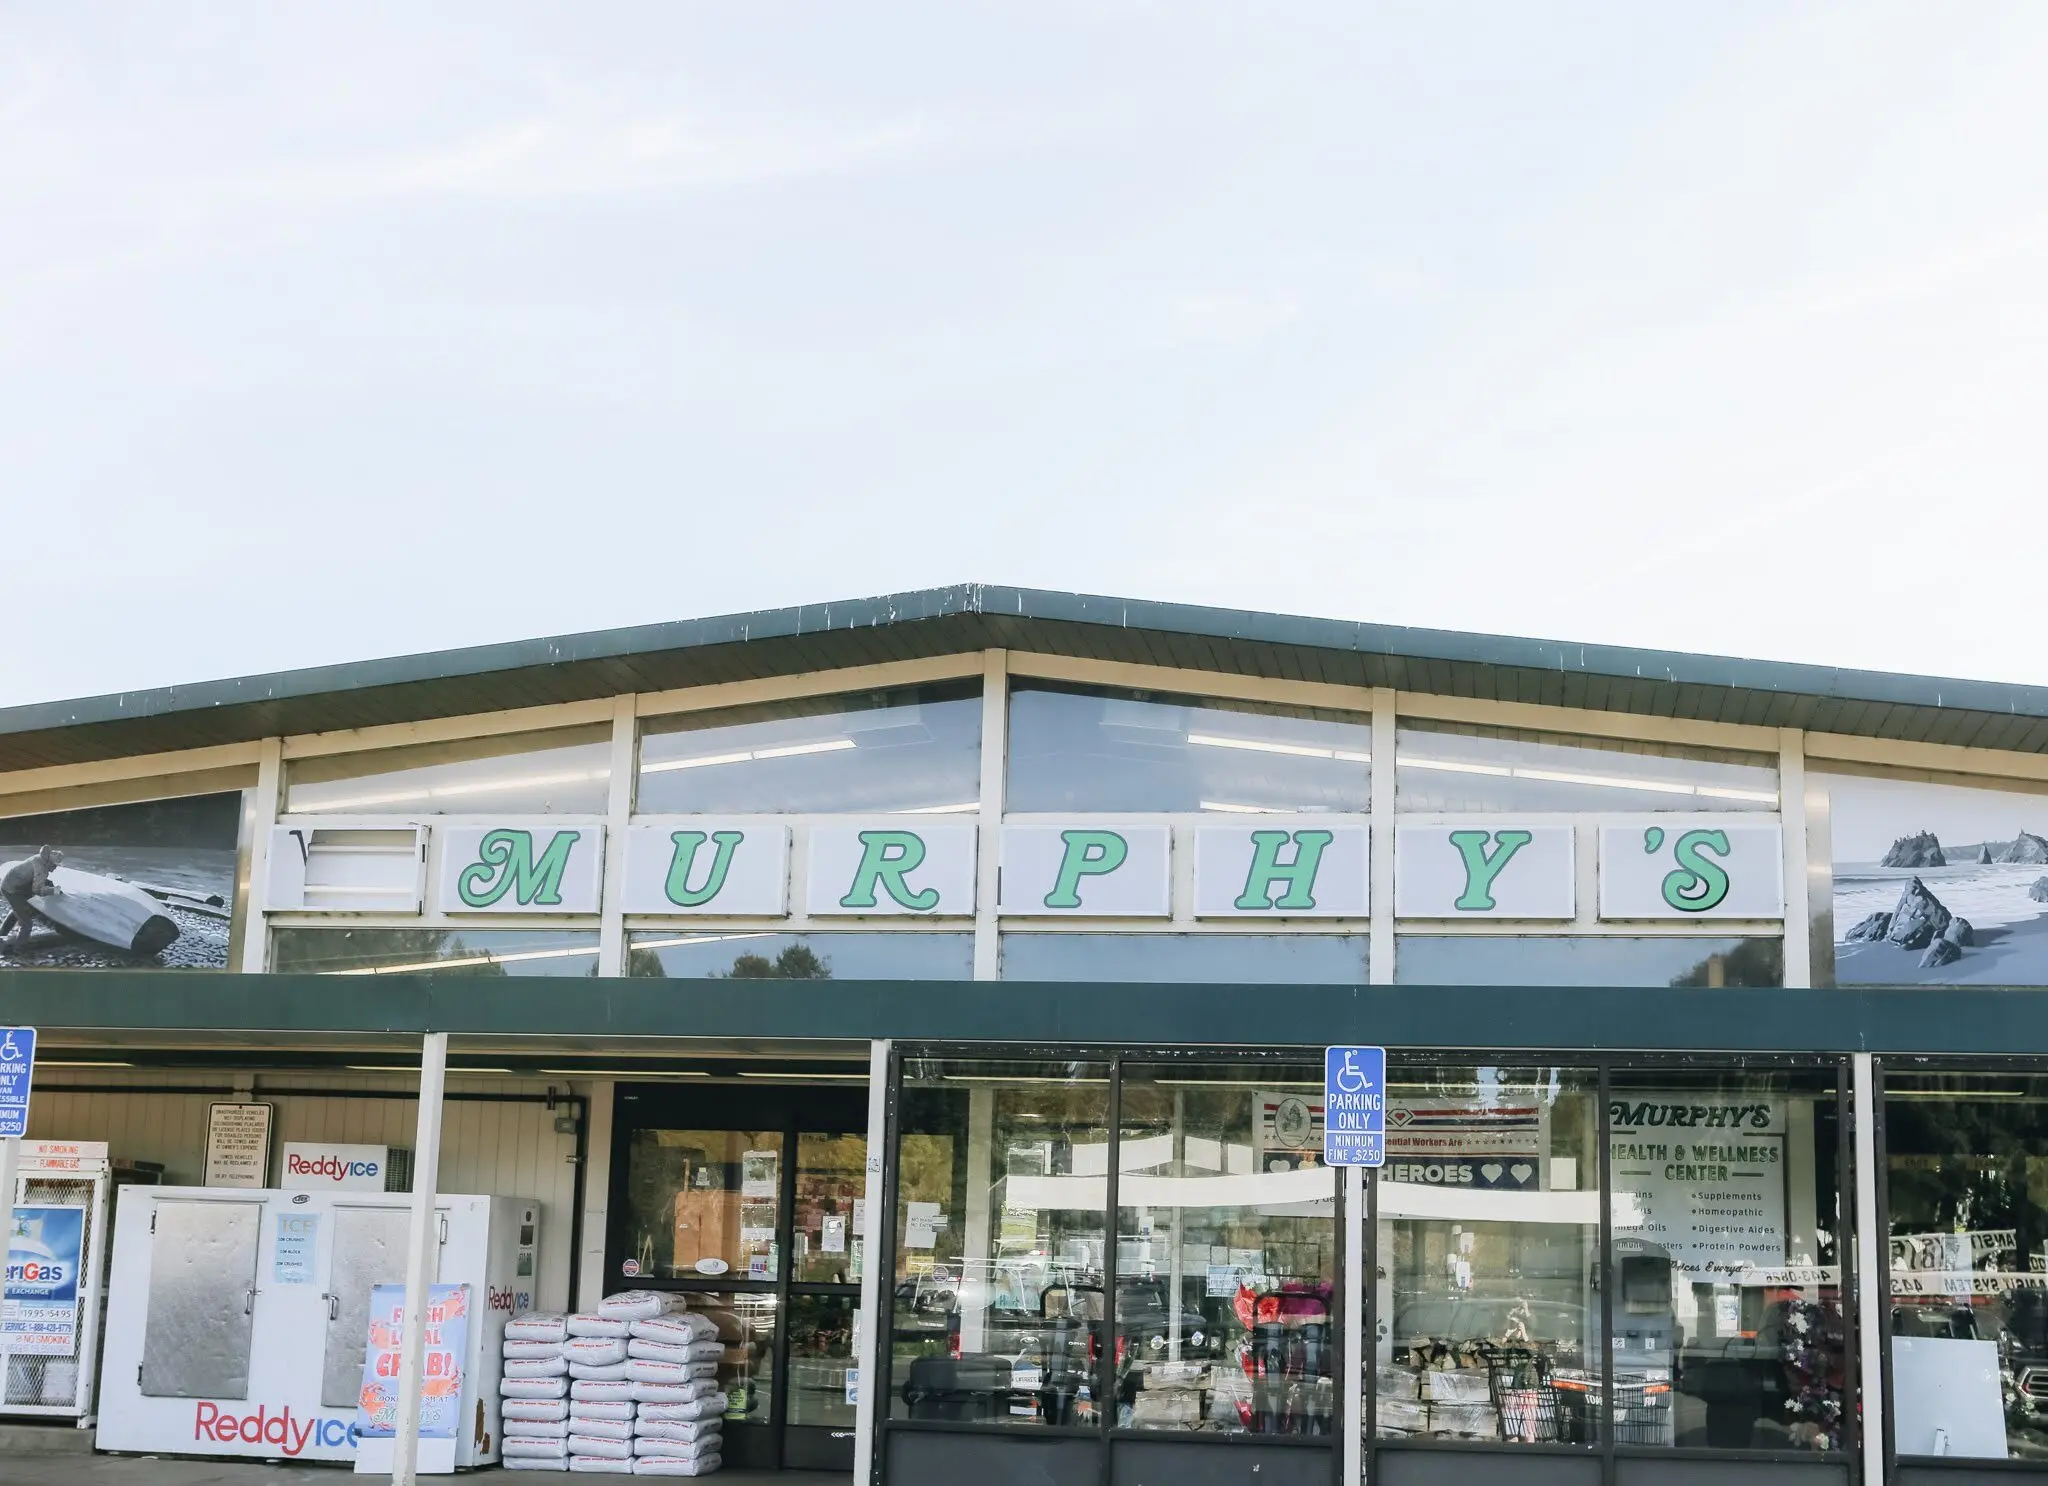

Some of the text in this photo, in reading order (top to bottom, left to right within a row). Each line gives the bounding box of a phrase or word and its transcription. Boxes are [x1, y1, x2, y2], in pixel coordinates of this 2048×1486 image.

[458, 826, 1731, 912] MURPHY'S
[0, 1062, 26, 1074] RKING
[0, 1075, 18, 1085] NLY
[0, 1095, 25, 1103] SSIBLE
[1329, 1093, 1381, 1111] PARKING
[1610, 1101, 1771, 1128] MURPHY'S
[1338, 1113, 1371, 1130] ONLY
[1335, 1135, 1374, 1147] MINIMUM
[1412, 1138, 1447, 1147] Workers
[1449, 1138, 1463, 1147] Are
[1328, 1149, 1380, 1162] FINE $250
[1674, 1144, 1686, 1161] &
[1692, 1145, 1779, 1163] WELLNESS
[1664, 1164, 1729, 1182] CENTER
[1698, 1191, 1762, 1201] Supplements
[1698, 1207, 1764, 1218] Homeopathic
[282, 1219, 314, 1233] ICE
[1647, 1223, 1667, 1232] Oils
[1699, 1224, 1775, 1235] Digestive Aides
[1699, 1242, 1781, 1252] Protein Powders
[5, 1262, 63, 1281] riGas
[11, 1288, 50, 1296] EXCHANGE
